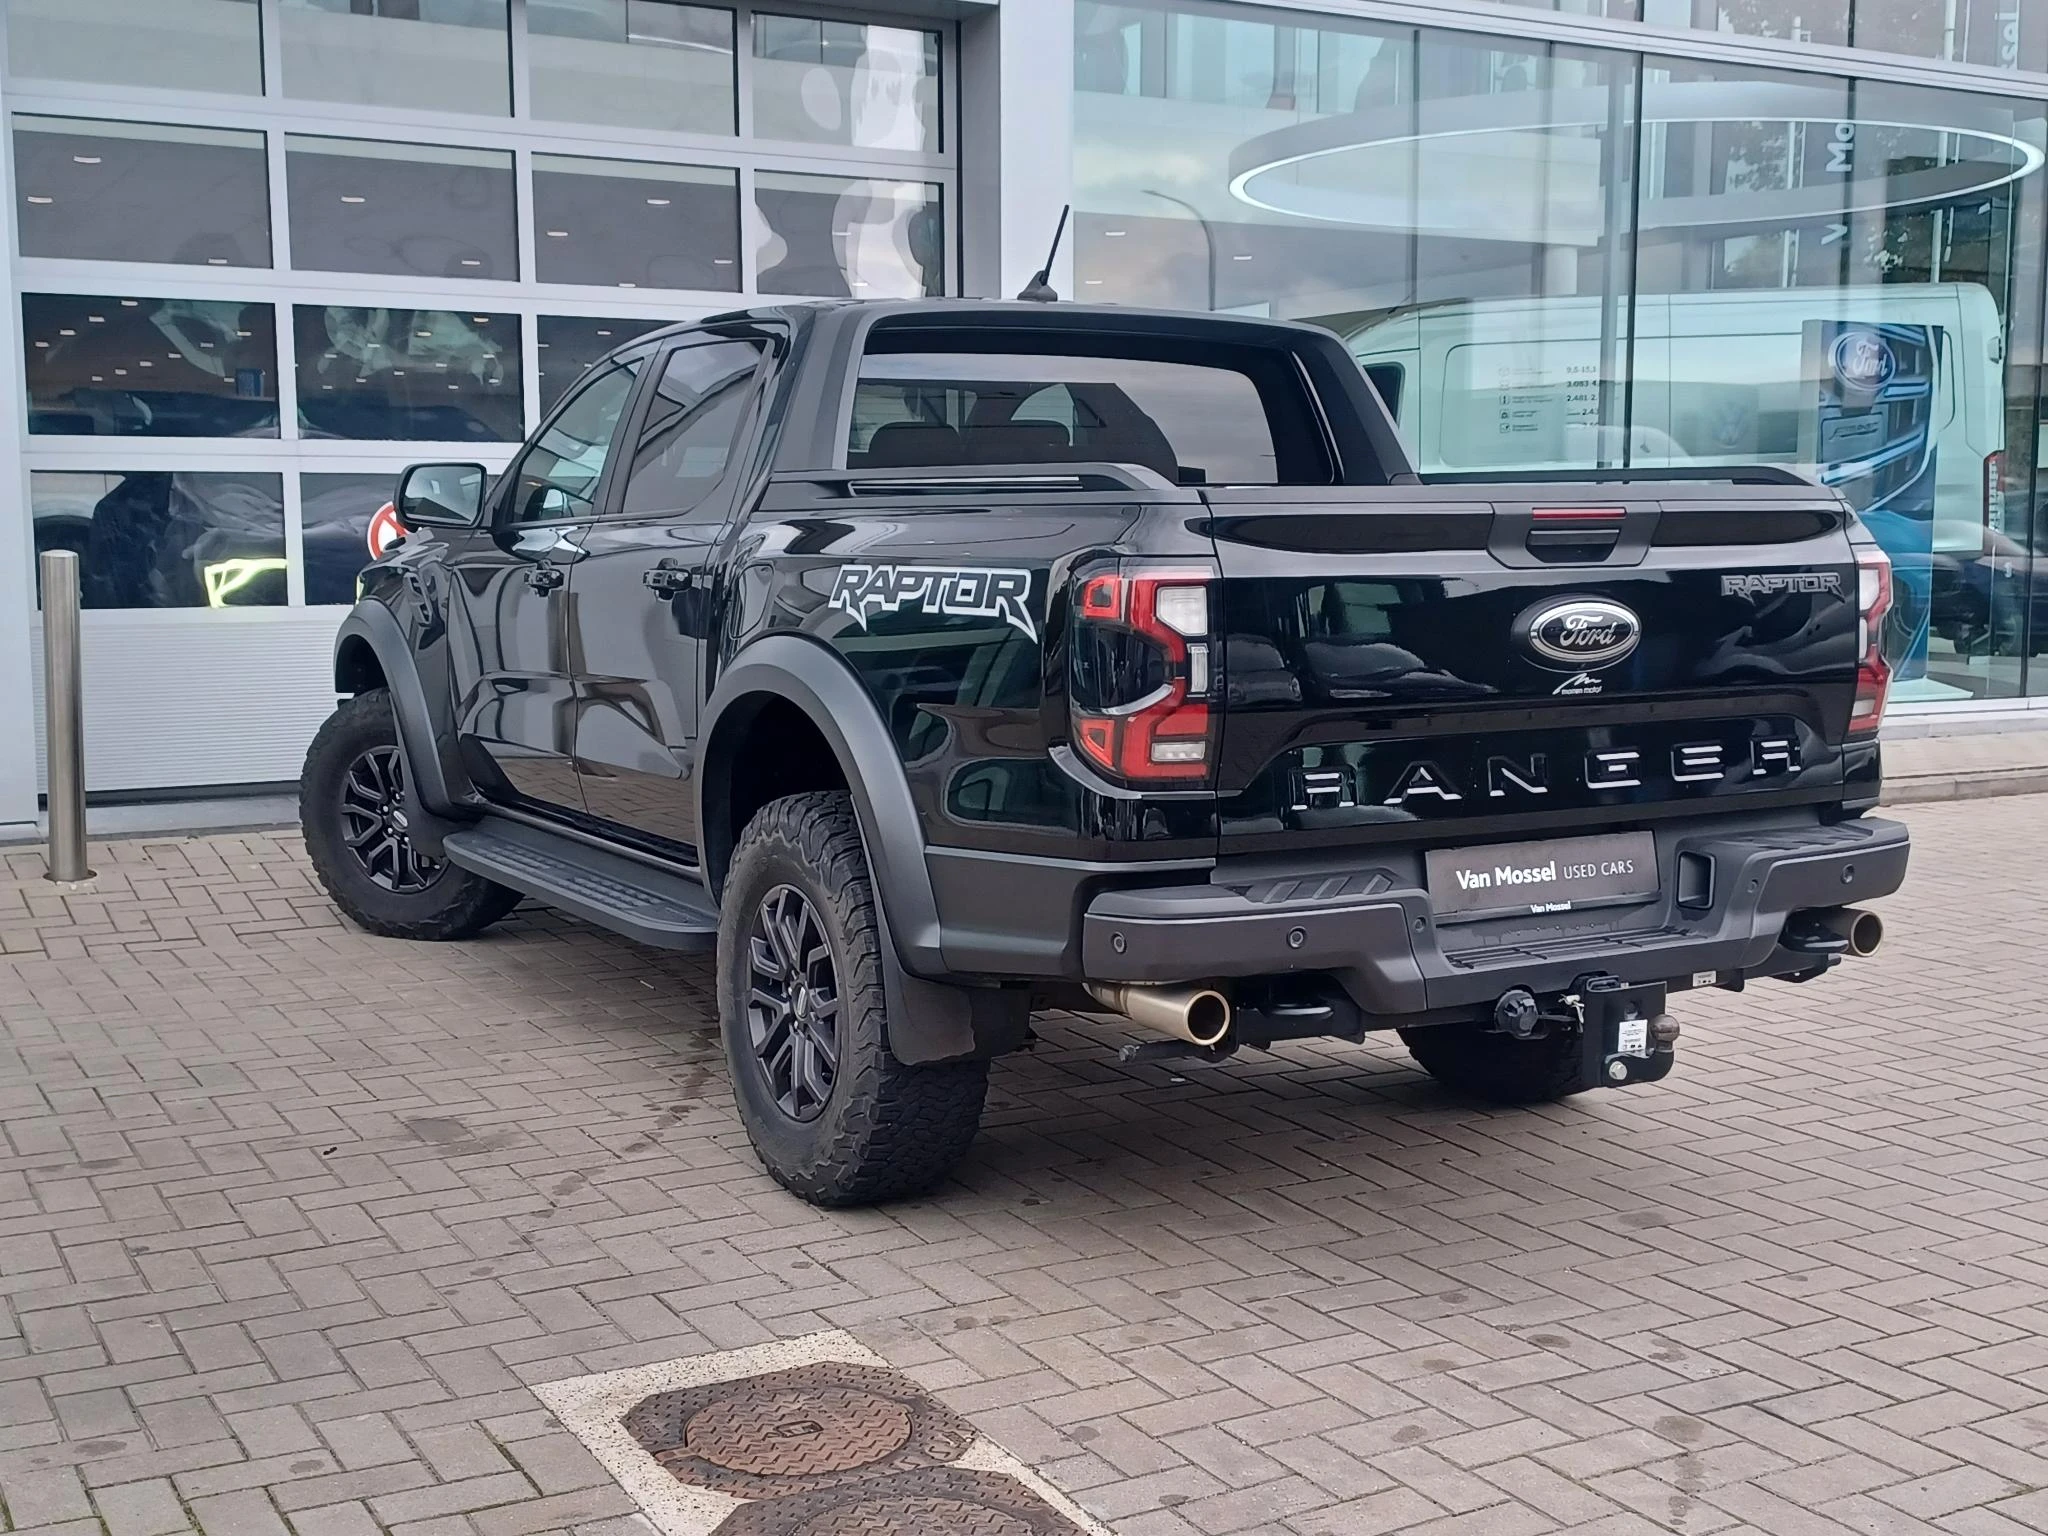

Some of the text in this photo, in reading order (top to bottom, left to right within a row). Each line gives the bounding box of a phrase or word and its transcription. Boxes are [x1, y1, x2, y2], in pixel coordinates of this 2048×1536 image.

[828, 564, 1038, 644] RAPTOR
[1721, 572, 1845, 606] RAPTOR
[1560, 614, 1617, 646] Ford
[1289, 736, 1802, 811] RANGER
[1456, 859, 1634, 890] Van Mossel USED CARS
[1530, 901, 1571, 914] Van Mossel
